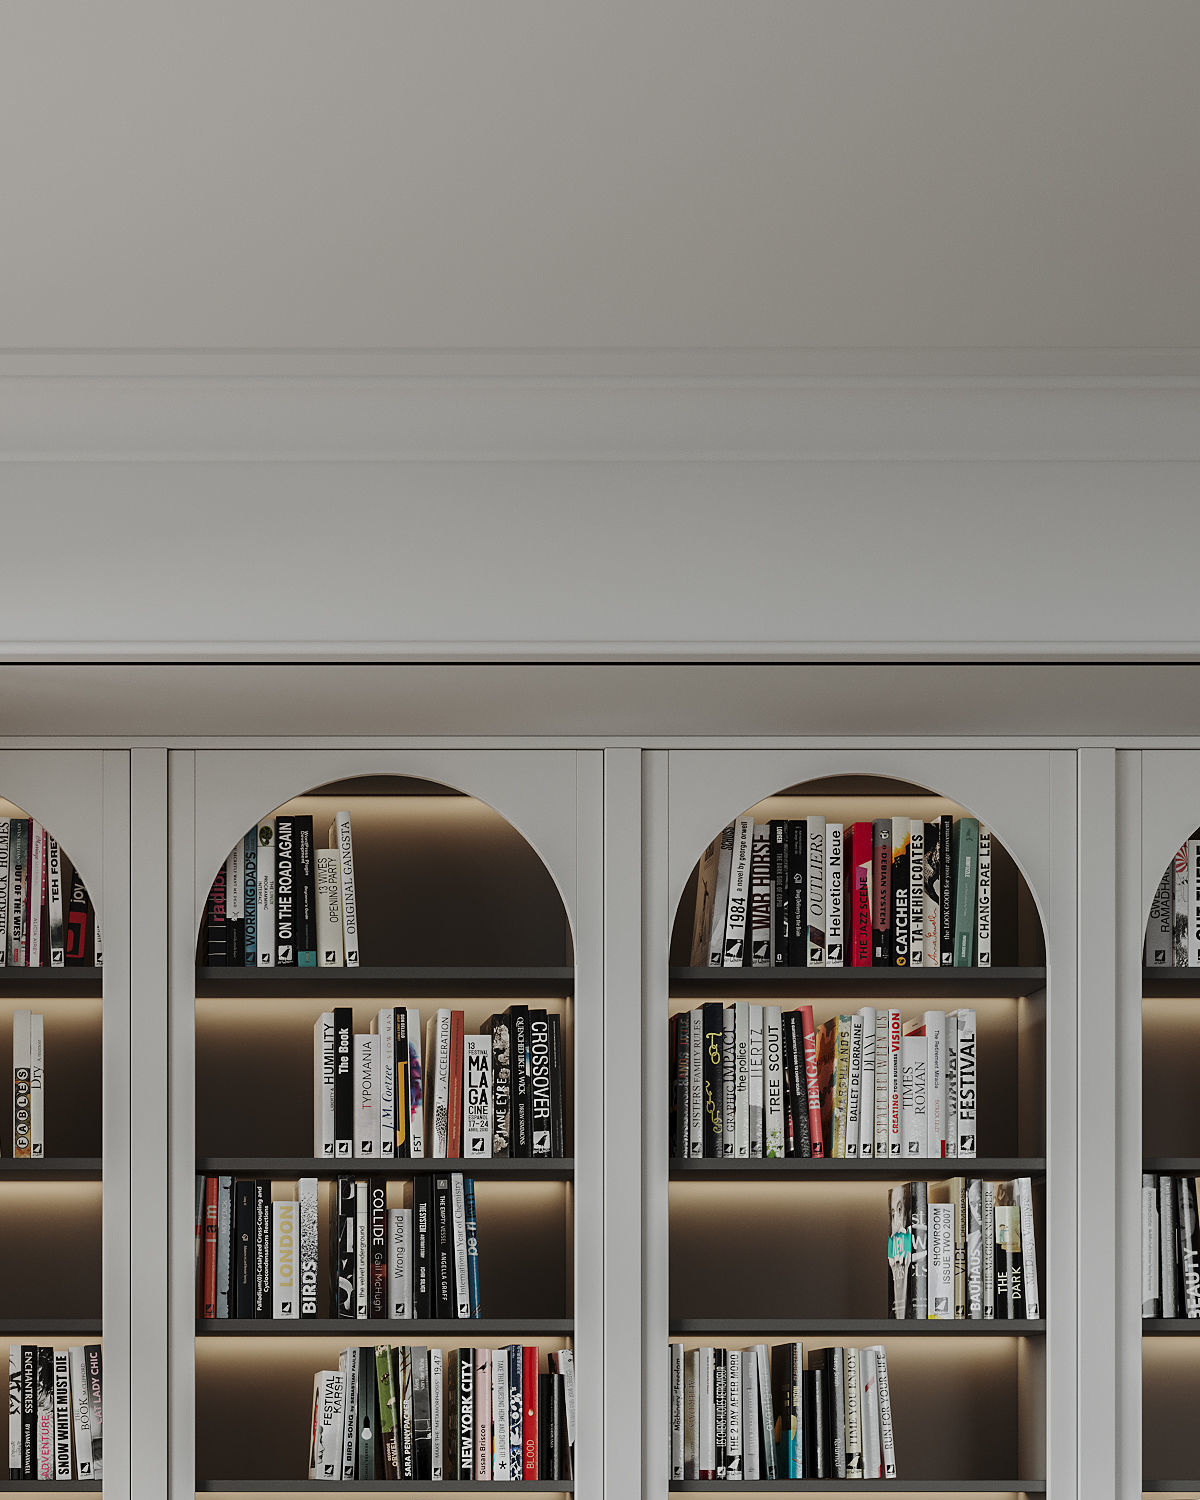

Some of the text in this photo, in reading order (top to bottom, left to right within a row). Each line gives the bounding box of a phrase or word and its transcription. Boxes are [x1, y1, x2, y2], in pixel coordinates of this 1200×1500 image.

[13, 864, 22, 883] OUT
[13, 885, 22, 896] OF
[246, 852, 256, 946] WORKING DAD'S
[278, 822, 292, 939] ON THE ROAD AGAIN
[318, 858, 328, 894] 13 WIVES
[328, 858, 339, 923] OPENING PARTY
[340, 821, 356, 934] ORIGINAL GANGSTA
[810, 833, 823, 916] OUTLIERS
[830, 830, 840, 936] Helvetica Neue
[980, 834, 990, 939] CHANG-RAE LEE
[13, 897, 22, 914] THE
[13, 916, 22, 943] WEST
[730, 897, 746, 930] 1984
[860, 877, 868, 960] THE JAZZ SCENE
[896, 888, 908, 955] CATCHER
[324, 1023, 334, 1085] HUMILITY
[338, 1028, 349, 1074] The Book
[440, 1017, 449, 1082] ACCELERATION
[892, 1012, 900, 1053] VISION
[362, 1041, 372, 1110] TYPOMANIA
[532, 1020, 550, 1118] CROSSOVER
[736, 1042, 748, 1092] the police
[768, 1026, 780, 1115] TREE SCOUT
[804, 1032, 820, 1110] BENGALA
[850, 1024, 861, 1122] BALLET DE LORRAINE
[902, 1066, 914, 1110] TIMES
[914, 1061, 926, 1115] ROMAN
[960, 1034, 974, 1120] FESTIVAL
[468, 1106, 488, 1114] CINE
[496, 1078, 509, 1134] JANE EYRE
[413, 1134, 421, 1152] FST
[280, 1206, 293, 1288] LONDON
[372, 1188, 384, 1246] COLLIDE
[394, 1215, 405, 1279] Wrong World
[302, 1260, 317, 1314] BIRDS
[970, 1249, 981, 1310] BAUHAUS
[998, 1271, 1008, 1295] THE
[1012, 1266, 1022, 1300] DARK
[24, 1351, 33, 1414] ENCHANTRESS
[324, 1376, 335, 1426] FESTIVAL
[334, 1376, 343, 1414] KARSH
[56, 1356, 69, 1475] SNOW WHITE MUST DIE
[462, 1360, 473, 1469] NEW YORK CITY
[42, 1415, 50, 1478] ADVENTURE
[526, 1440, 534, 1469] BLOOD
